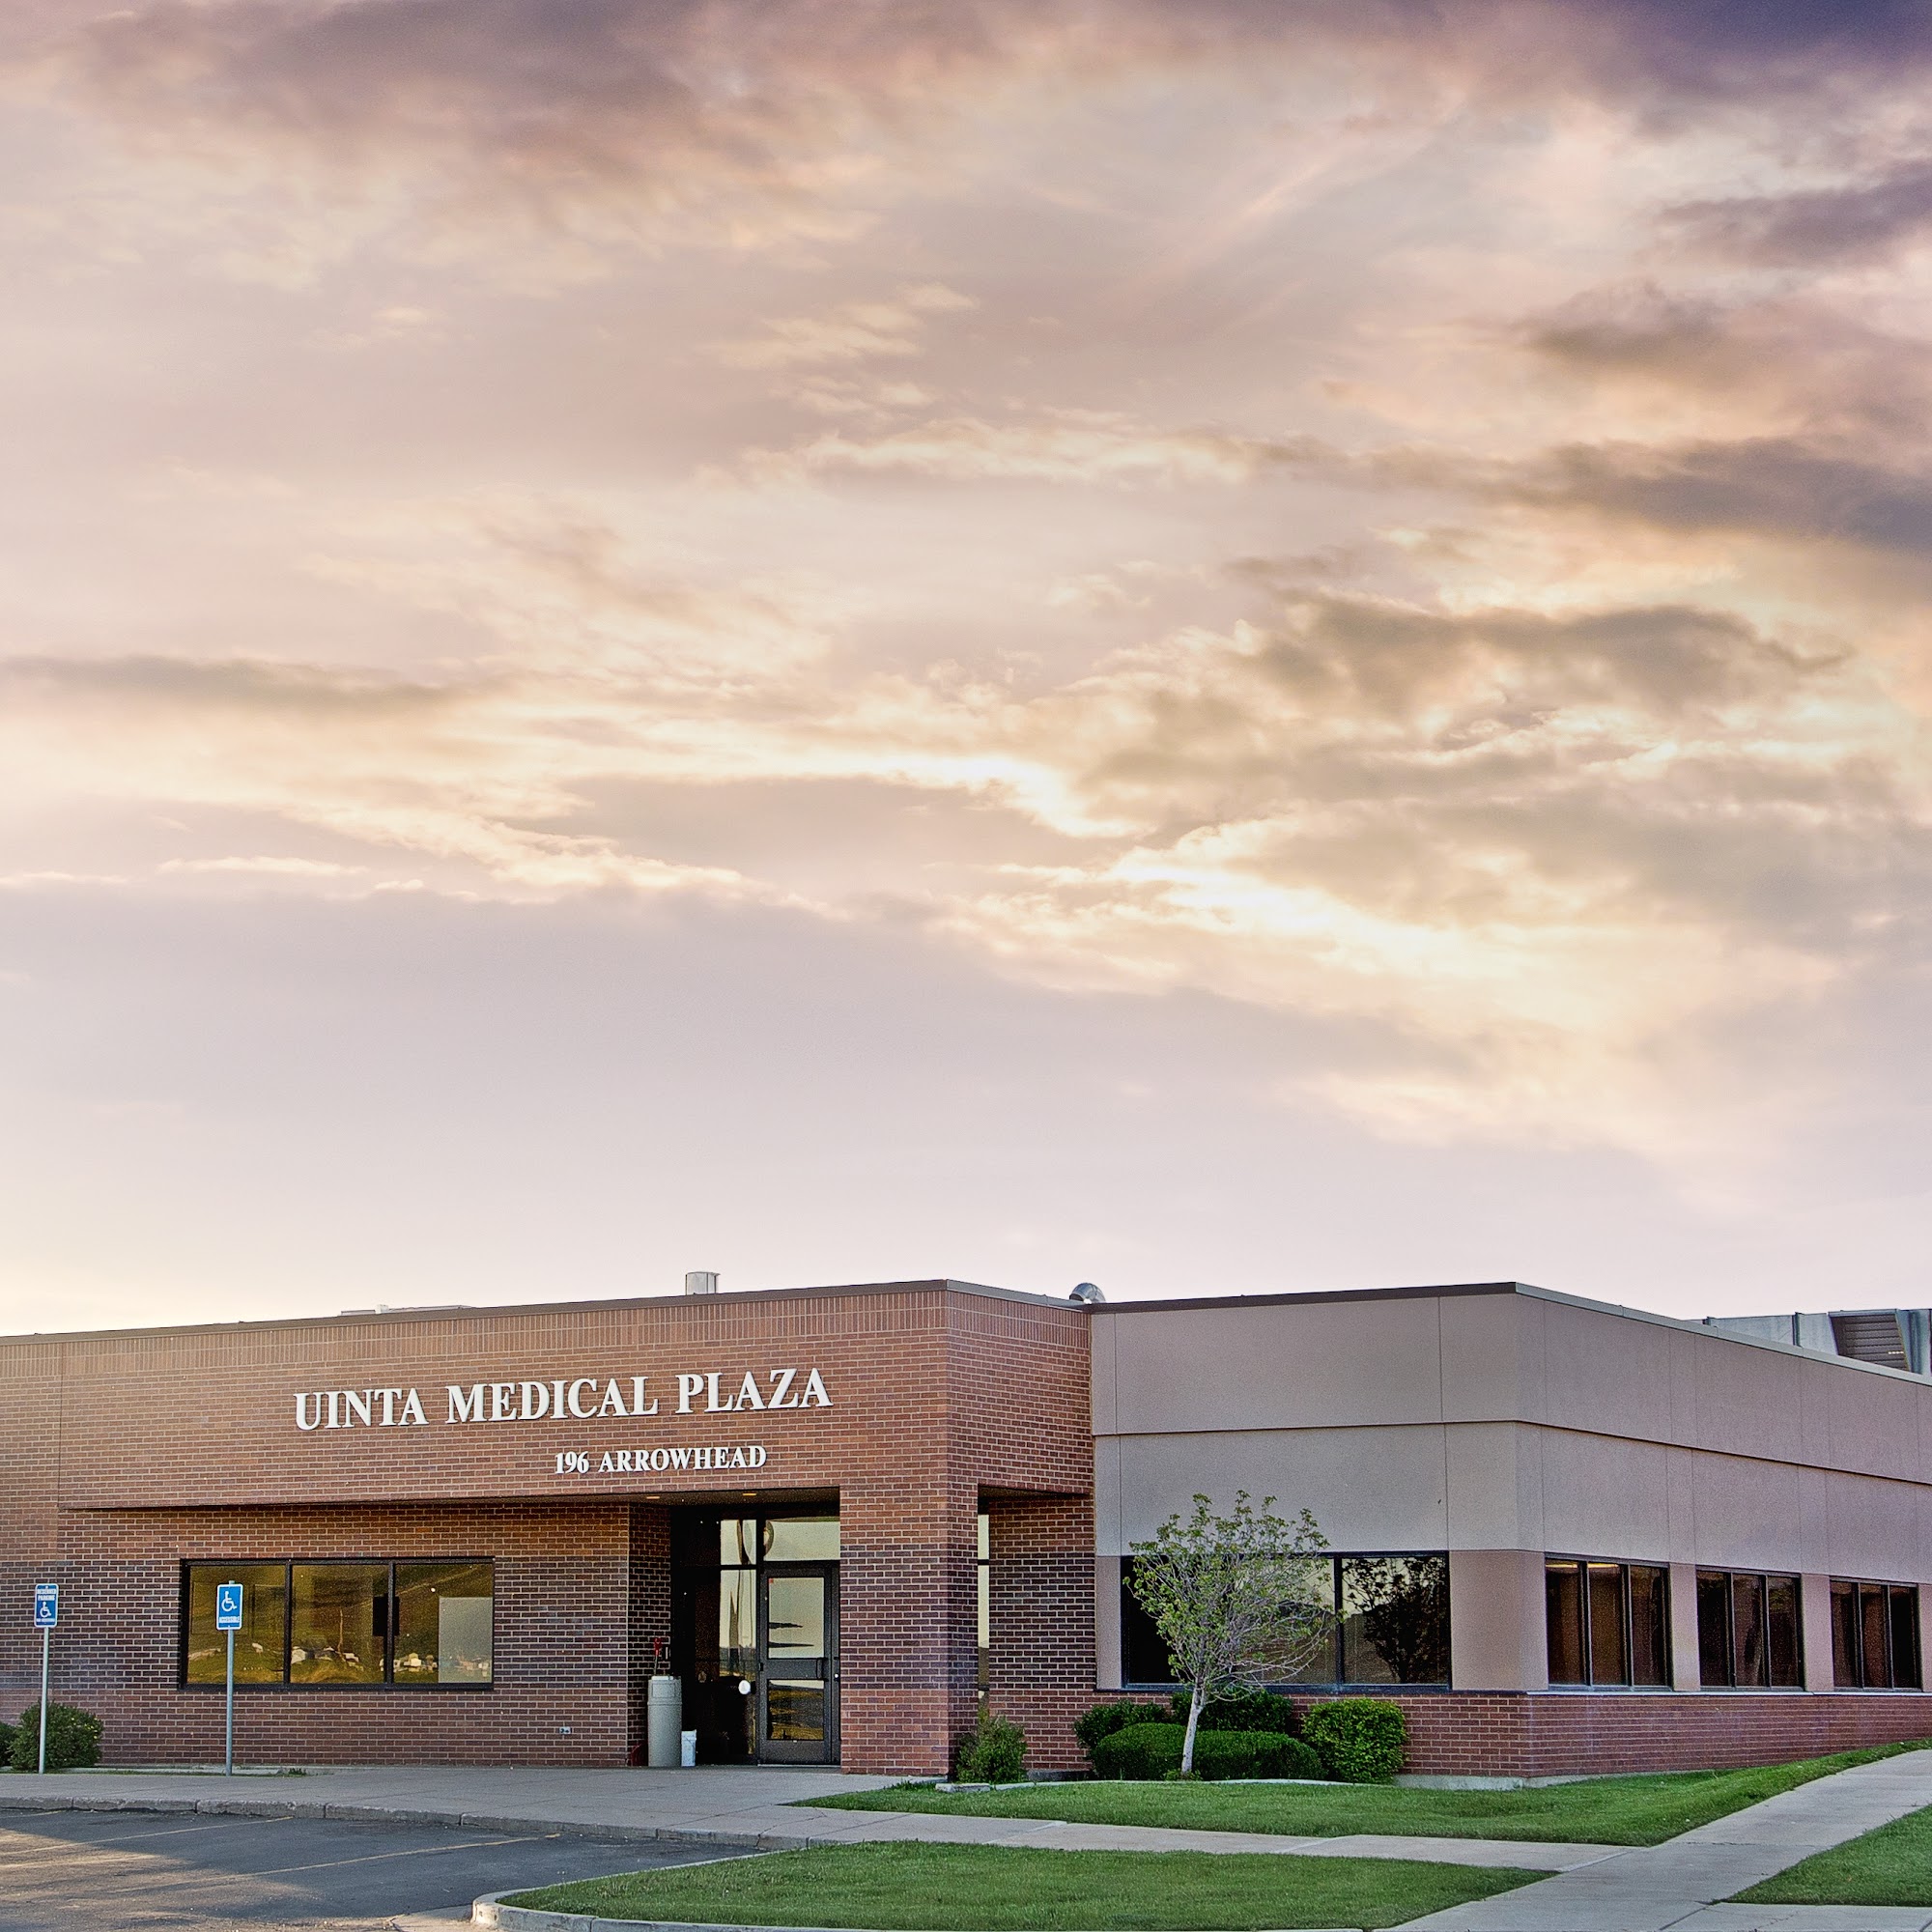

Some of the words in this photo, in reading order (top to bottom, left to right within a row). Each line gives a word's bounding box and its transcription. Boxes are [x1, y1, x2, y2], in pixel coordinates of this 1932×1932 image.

[293, 1387, 429, 1431] UINTA
[444, 1377, 659, 1424] MEDICAL
[675, 1367, 835, 1414] PLAZA
[554, 1451, 590, 1474] 196
[597, 1445, 767, 1473] ARROWHEAD
